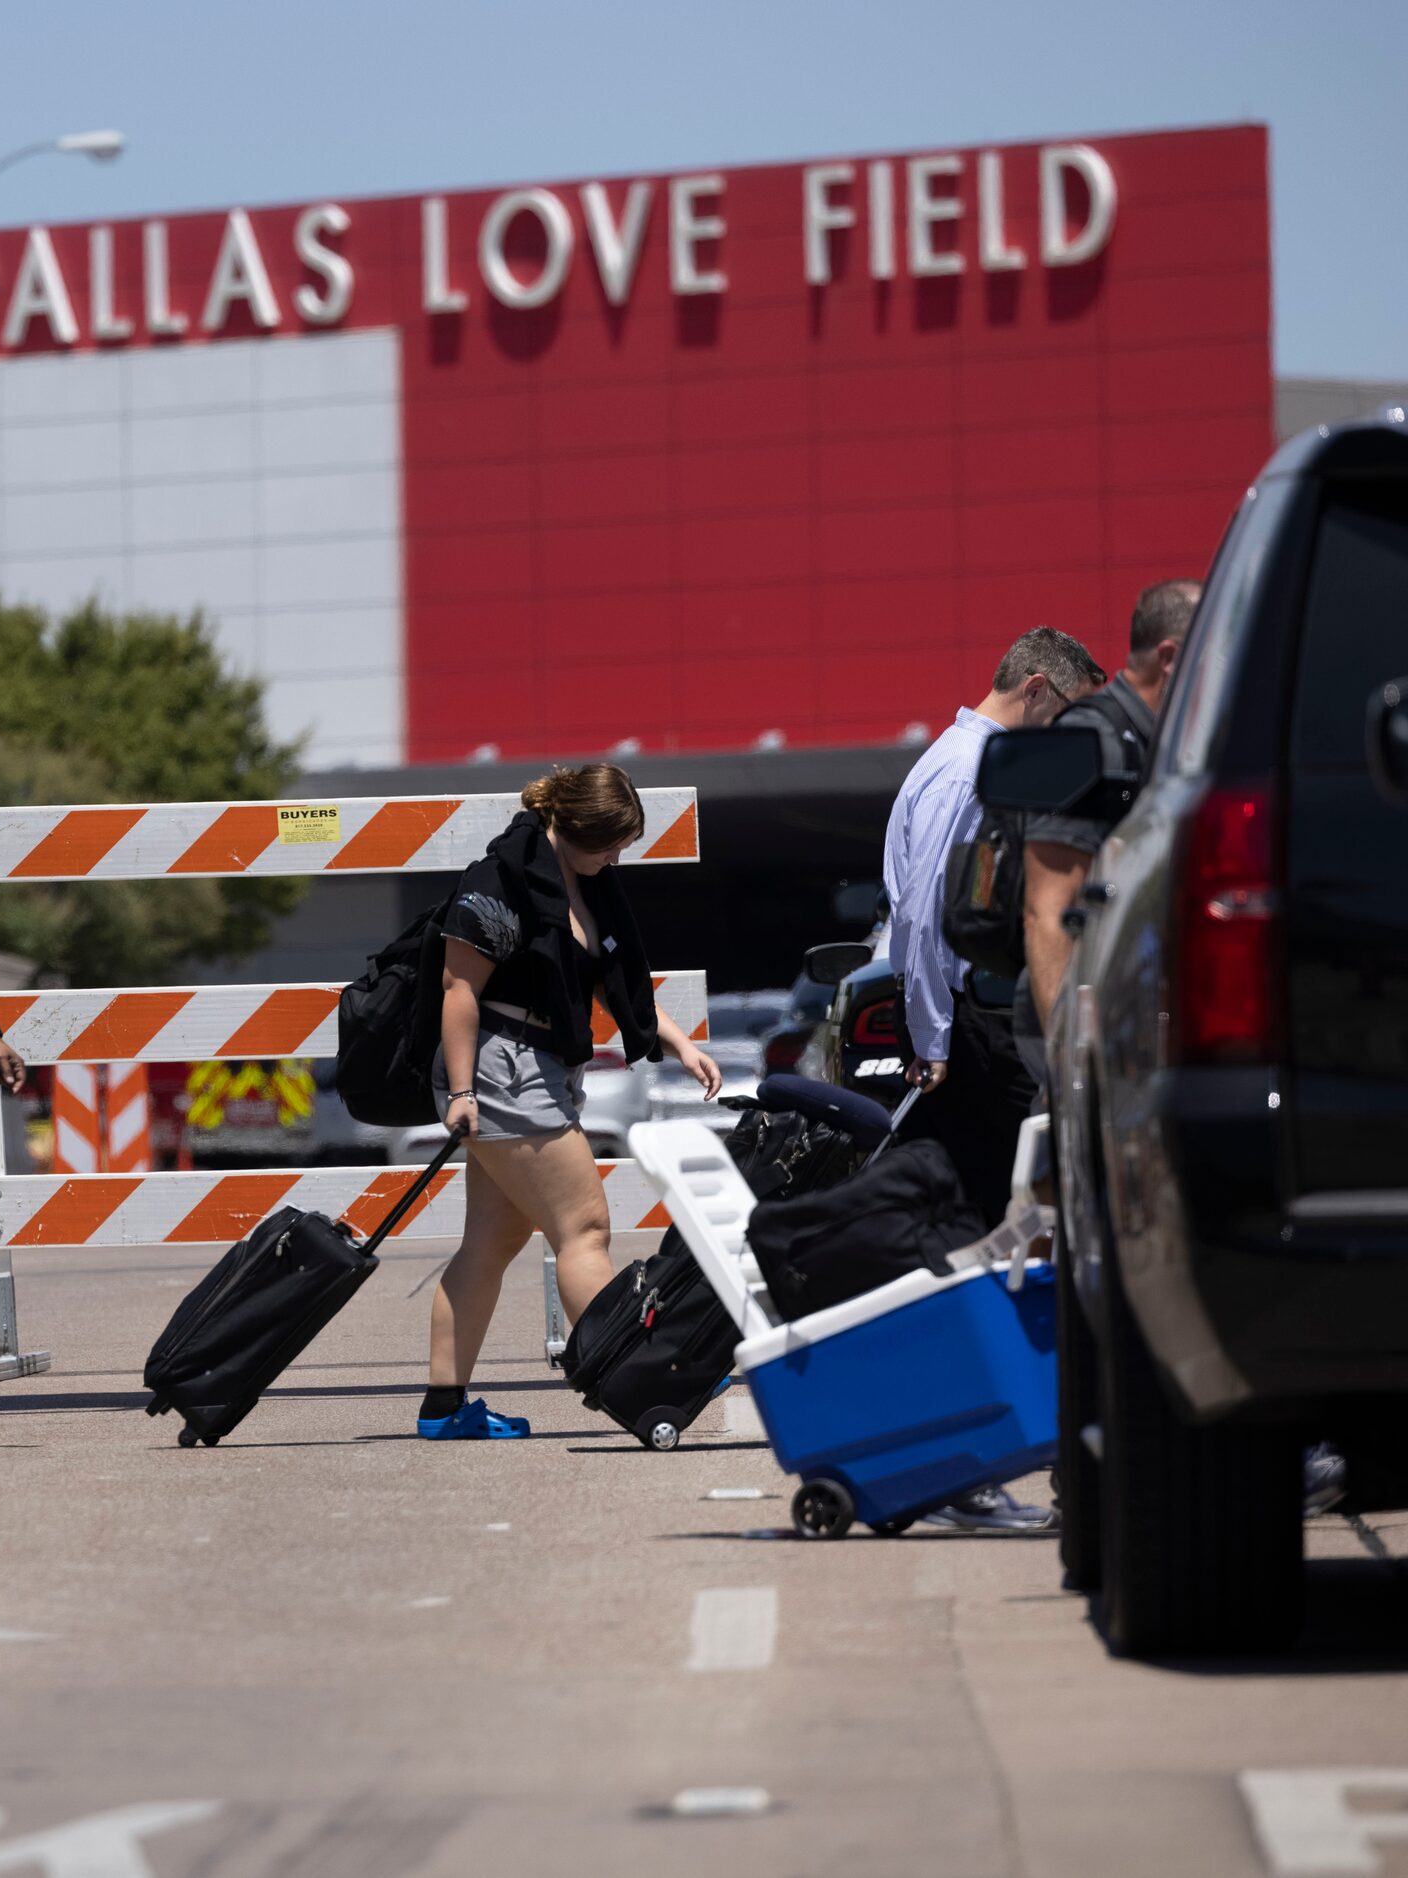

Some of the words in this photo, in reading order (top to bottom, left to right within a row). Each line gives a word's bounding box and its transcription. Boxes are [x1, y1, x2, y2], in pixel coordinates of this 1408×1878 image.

[421, 173, 730, 314] LOVE
[802, 144, 1119, 285] FIELD
[280, 809, 338, 819] BUYERS
[854, 1057, 905, 1077] 80
